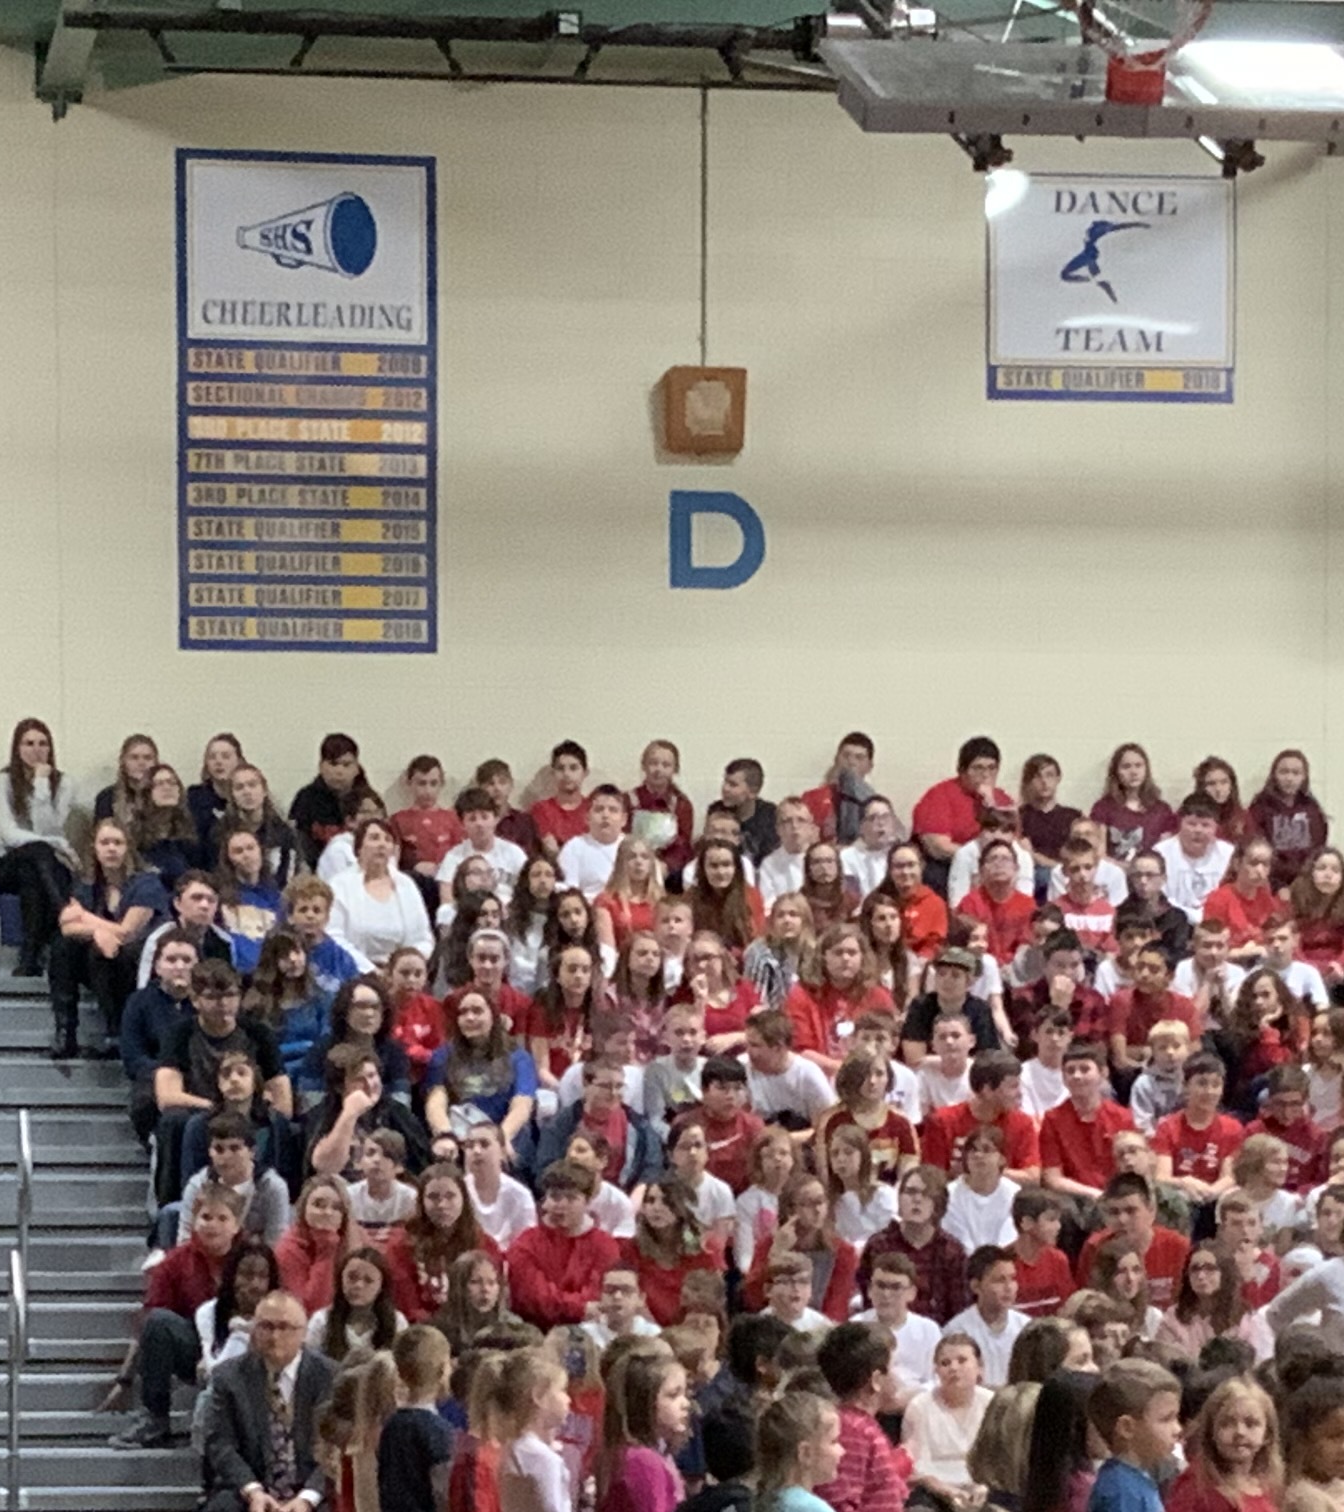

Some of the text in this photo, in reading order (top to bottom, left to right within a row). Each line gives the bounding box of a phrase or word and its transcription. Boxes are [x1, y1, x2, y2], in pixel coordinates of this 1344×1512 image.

[1054, 189, 1178, 216] DANCE
[258, 218, 316, 256] SHS
[201, 298, 414, 333] CHEERLEADING
[1055, 327, 1164, 353] TEAM
[192, 350, 246, 370] STATE
[255, 351, 341, 374] QUALIFIER
[1003, 368, 1053, 388] STATE
[1061, 370, 1146, 390] QUALIFIER
[192, 384, 285, 405] SECTIONAL
[382, 390, 423, 408] 2012
[233, 452, 287, 473] PLACE
[296, 455, 346, 475] STATE
[235, 486, 287, 506] PLACE
[298, 488, 349, 508] STATE
[193, 519, 421, 541] STATE QUALIFIER 2015
[669, 490, 767, 589] D
[193, 553, 246, 572] STATE
[255, 554, 341, 575] QUALIFIER
[194, 586, 421, 609] STATE QUALIFIER 2017
[195, 618, 247, 638] STATE
[256, 619, 343, 641] QUALIFIER
